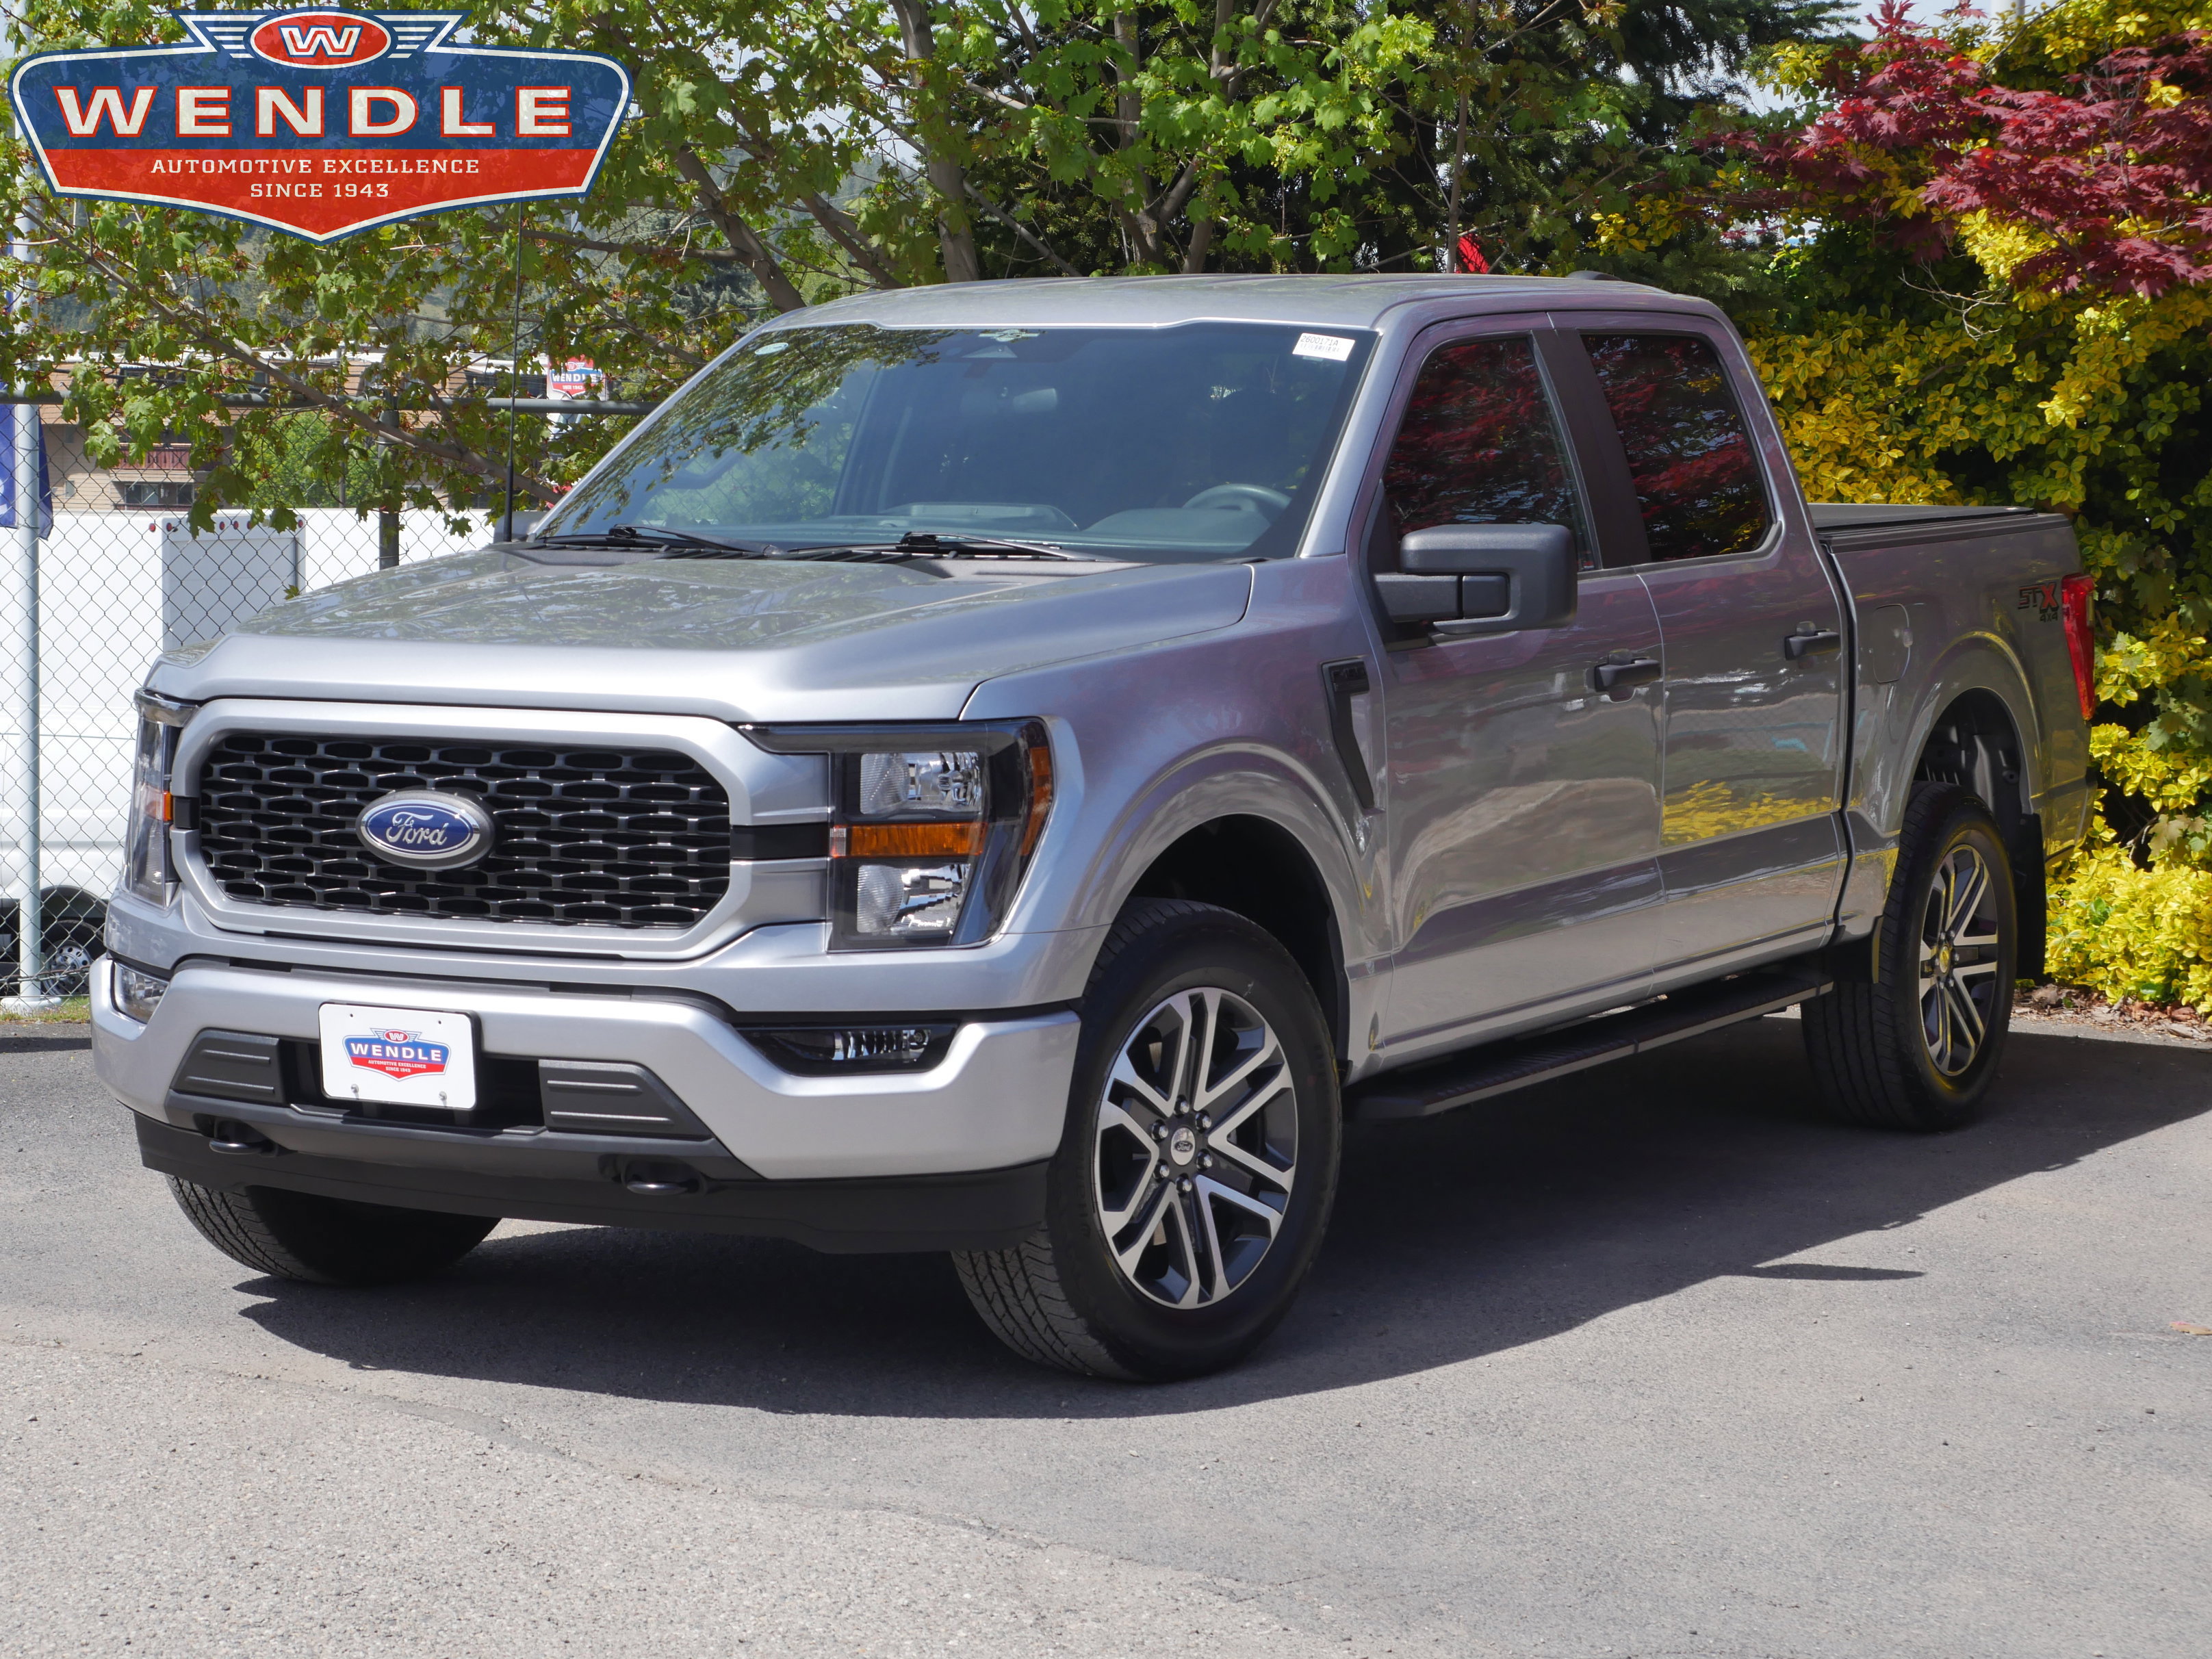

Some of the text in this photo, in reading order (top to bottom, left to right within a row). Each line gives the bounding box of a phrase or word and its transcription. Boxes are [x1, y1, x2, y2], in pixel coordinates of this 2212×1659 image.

[2018, 583, 2059, 613] STX
[386, 811, 449, 845] Ford
[350, 1043, 441, 1062] WENDLE
